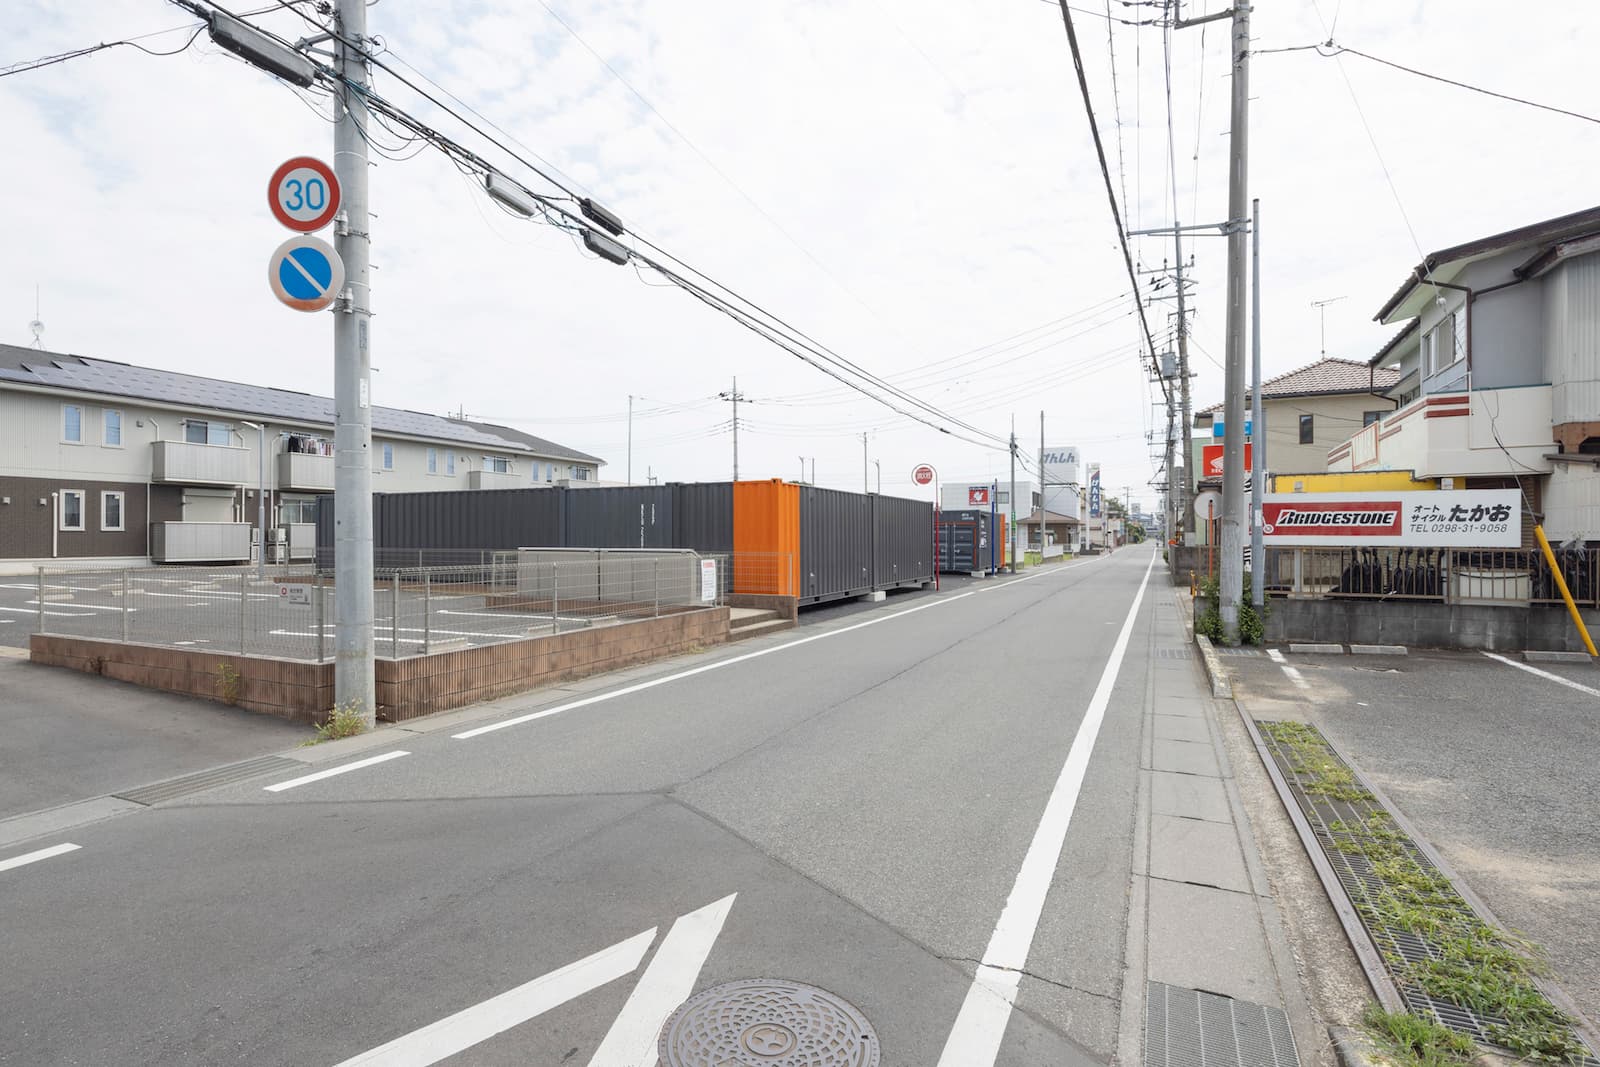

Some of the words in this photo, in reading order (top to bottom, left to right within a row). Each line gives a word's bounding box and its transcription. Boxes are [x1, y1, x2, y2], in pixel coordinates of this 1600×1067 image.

[285, 178, 325, 211] 30
[1091, 479, 1099, 510] けんしん
[1414, 504, 1440, 513] オート
[1448, 504, 1512, 522] たかお
[1278, 511, 1394, 525] BRIDGESTONE
[1411, 514, 1447, 523] サイクル
[1410, 524, 1428, 533] TEL
